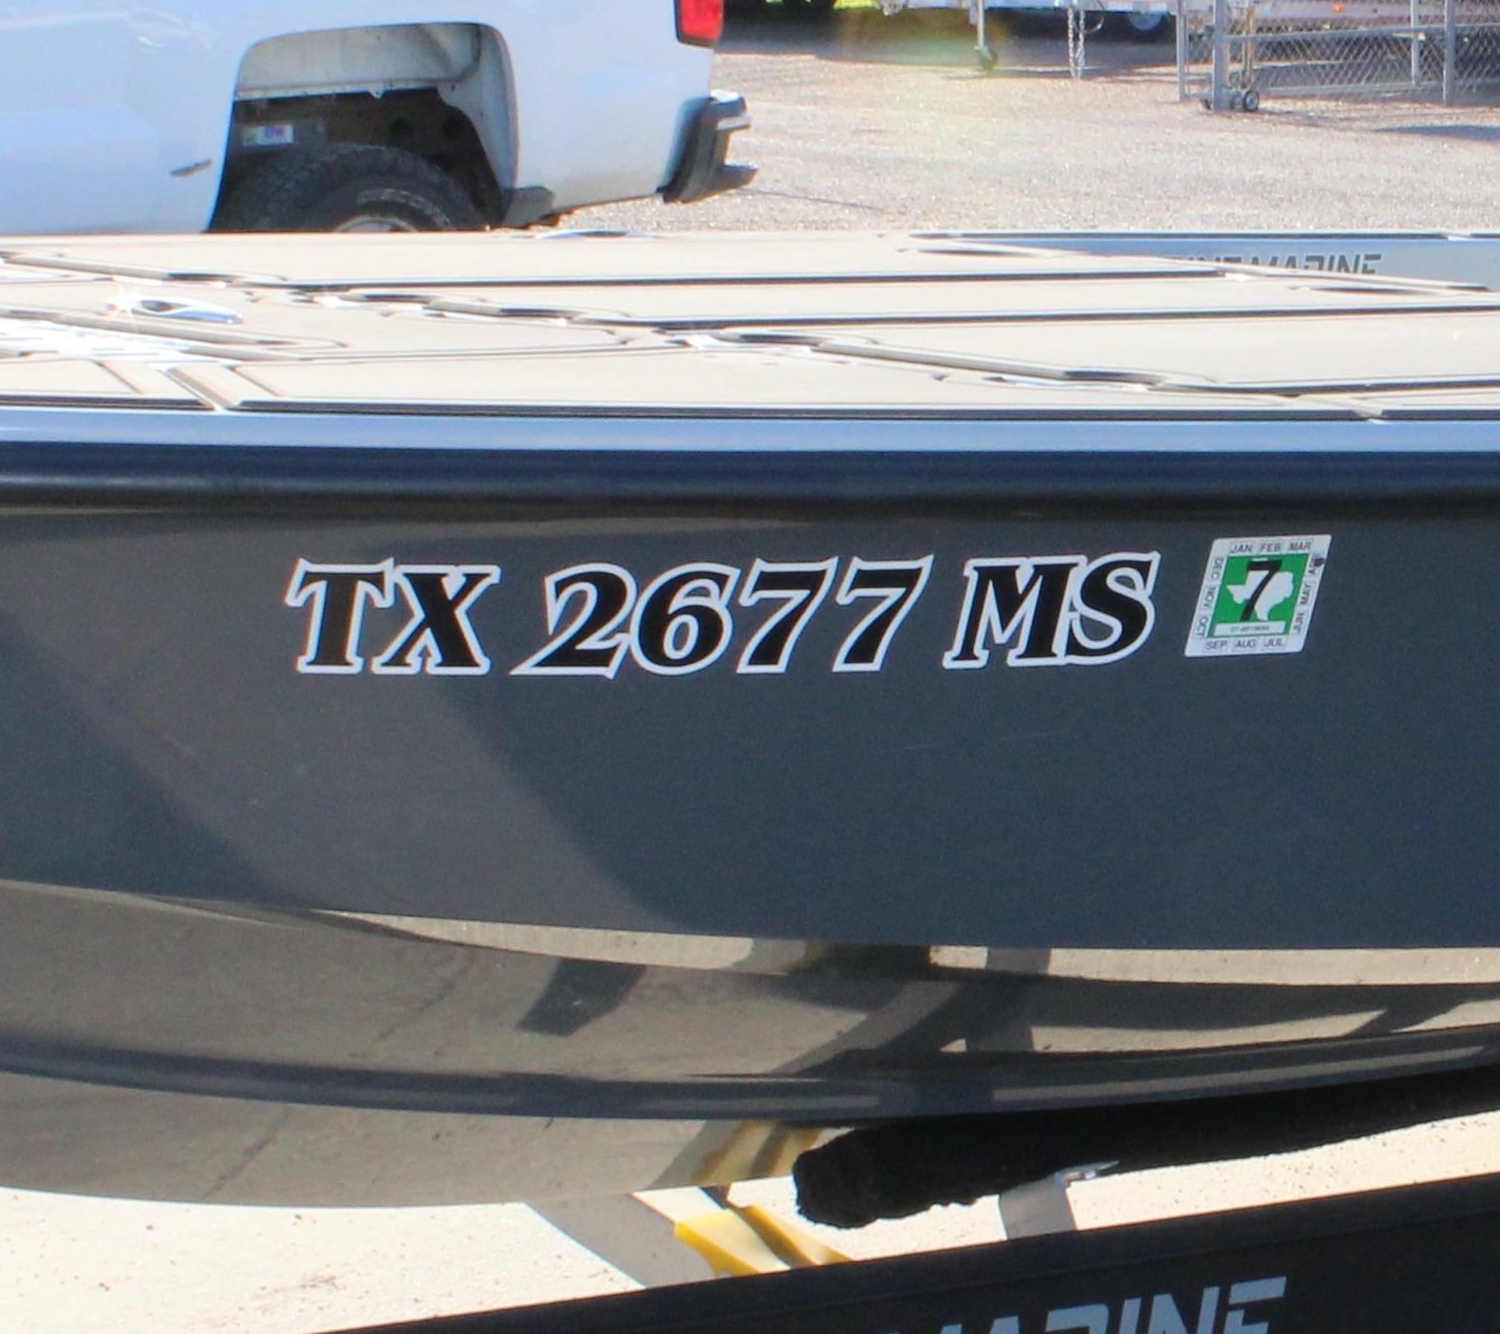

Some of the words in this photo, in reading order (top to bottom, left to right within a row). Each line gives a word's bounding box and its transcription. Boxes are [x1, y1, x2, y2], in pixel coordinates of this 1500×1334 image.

[1230, 543, 1252, 554] JAN
[1260, 542, 1282, 553] FEB
[1288, 541, 1312, 552] MAR
[1239, 558, 1283, 622] 7
[1300, 584, 1312, 605] MAY
[283, 556, 501, 675] TX
[510, 555, 932, 680] 2677
[942, 551, 1161, 671] MS
[1206, 640, 1228, 651] SEP
[1234, 639, 1257, 649] AUG
[1263, 638, 1285, 648] JUL
